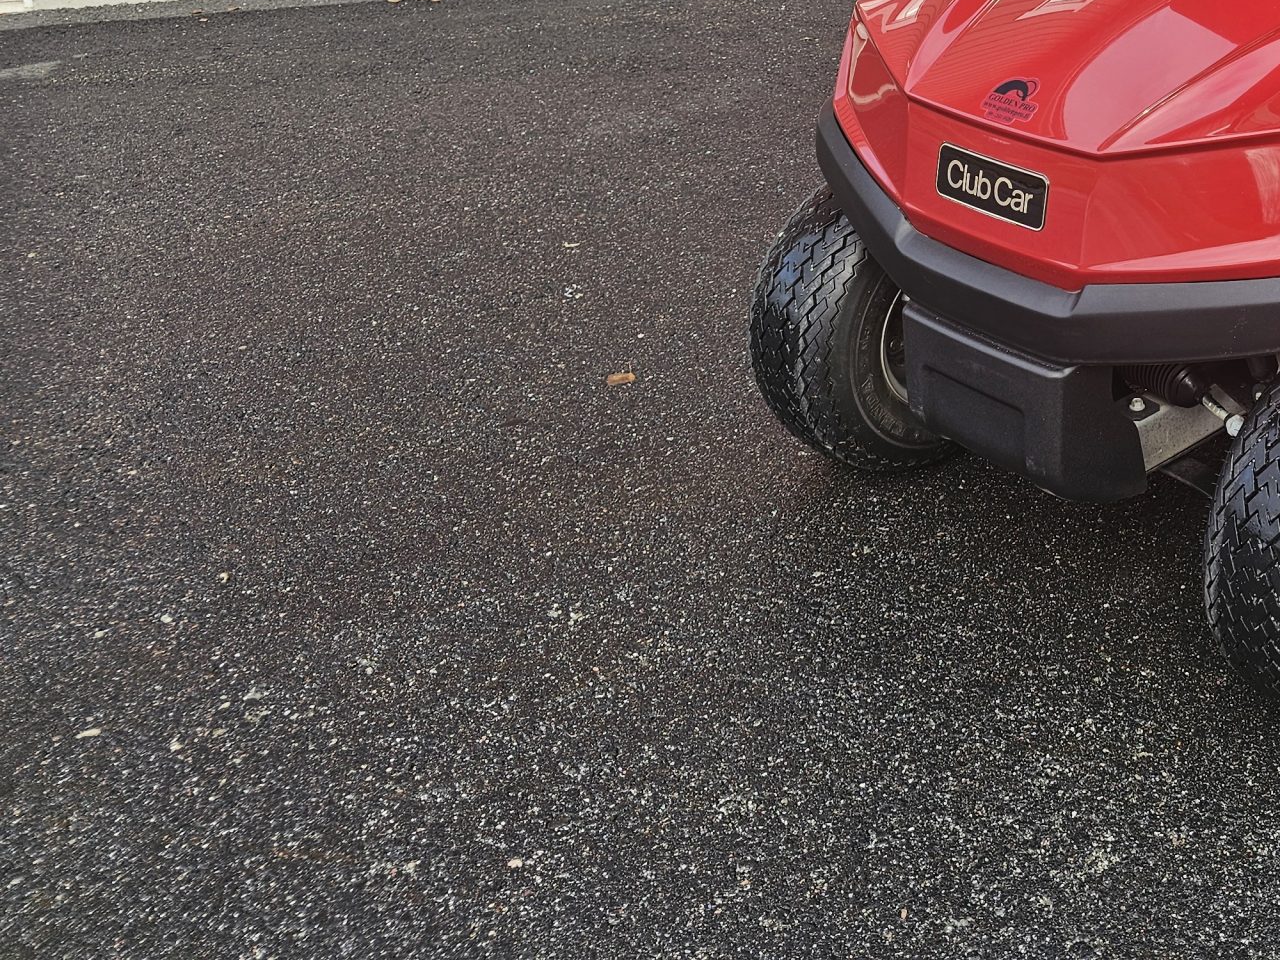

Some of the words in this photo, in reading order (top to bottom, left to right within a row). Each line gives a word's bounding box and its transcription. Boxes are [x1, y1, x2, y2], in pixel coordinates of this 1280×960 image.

[1018, 102, 1036, 112] PRO
[947, 159, 991, 200] Club
[993, 176, 1033, 214] Car
